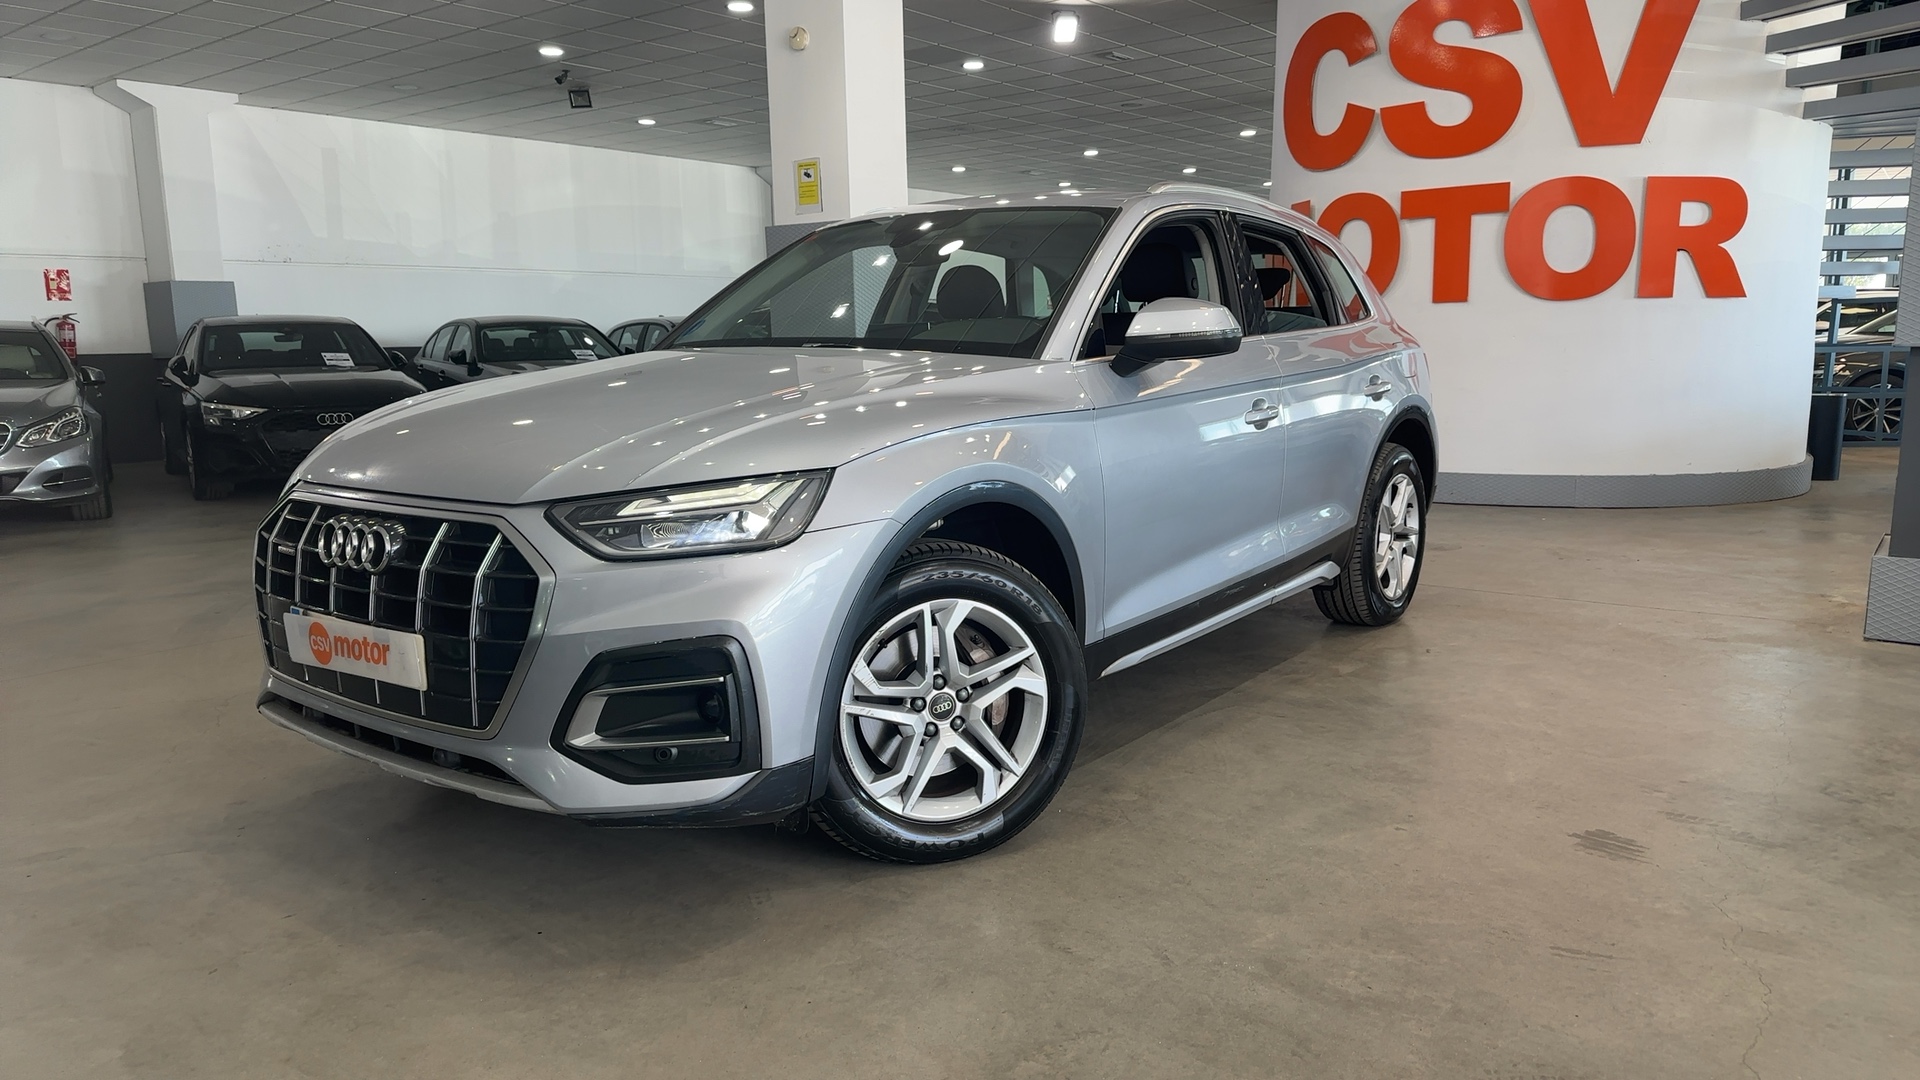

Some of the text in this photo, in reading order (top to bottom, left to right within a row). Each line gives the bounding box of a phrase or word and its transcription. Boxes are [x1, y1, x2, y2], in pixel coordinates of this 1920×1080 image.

[1283, 0, 1699, 171] CSV
[1290, 176, 1749, 304] OTOR
[921, 570, 1044, 616] 235/60 R18
[310, 634, 390, 666] CSV motor
